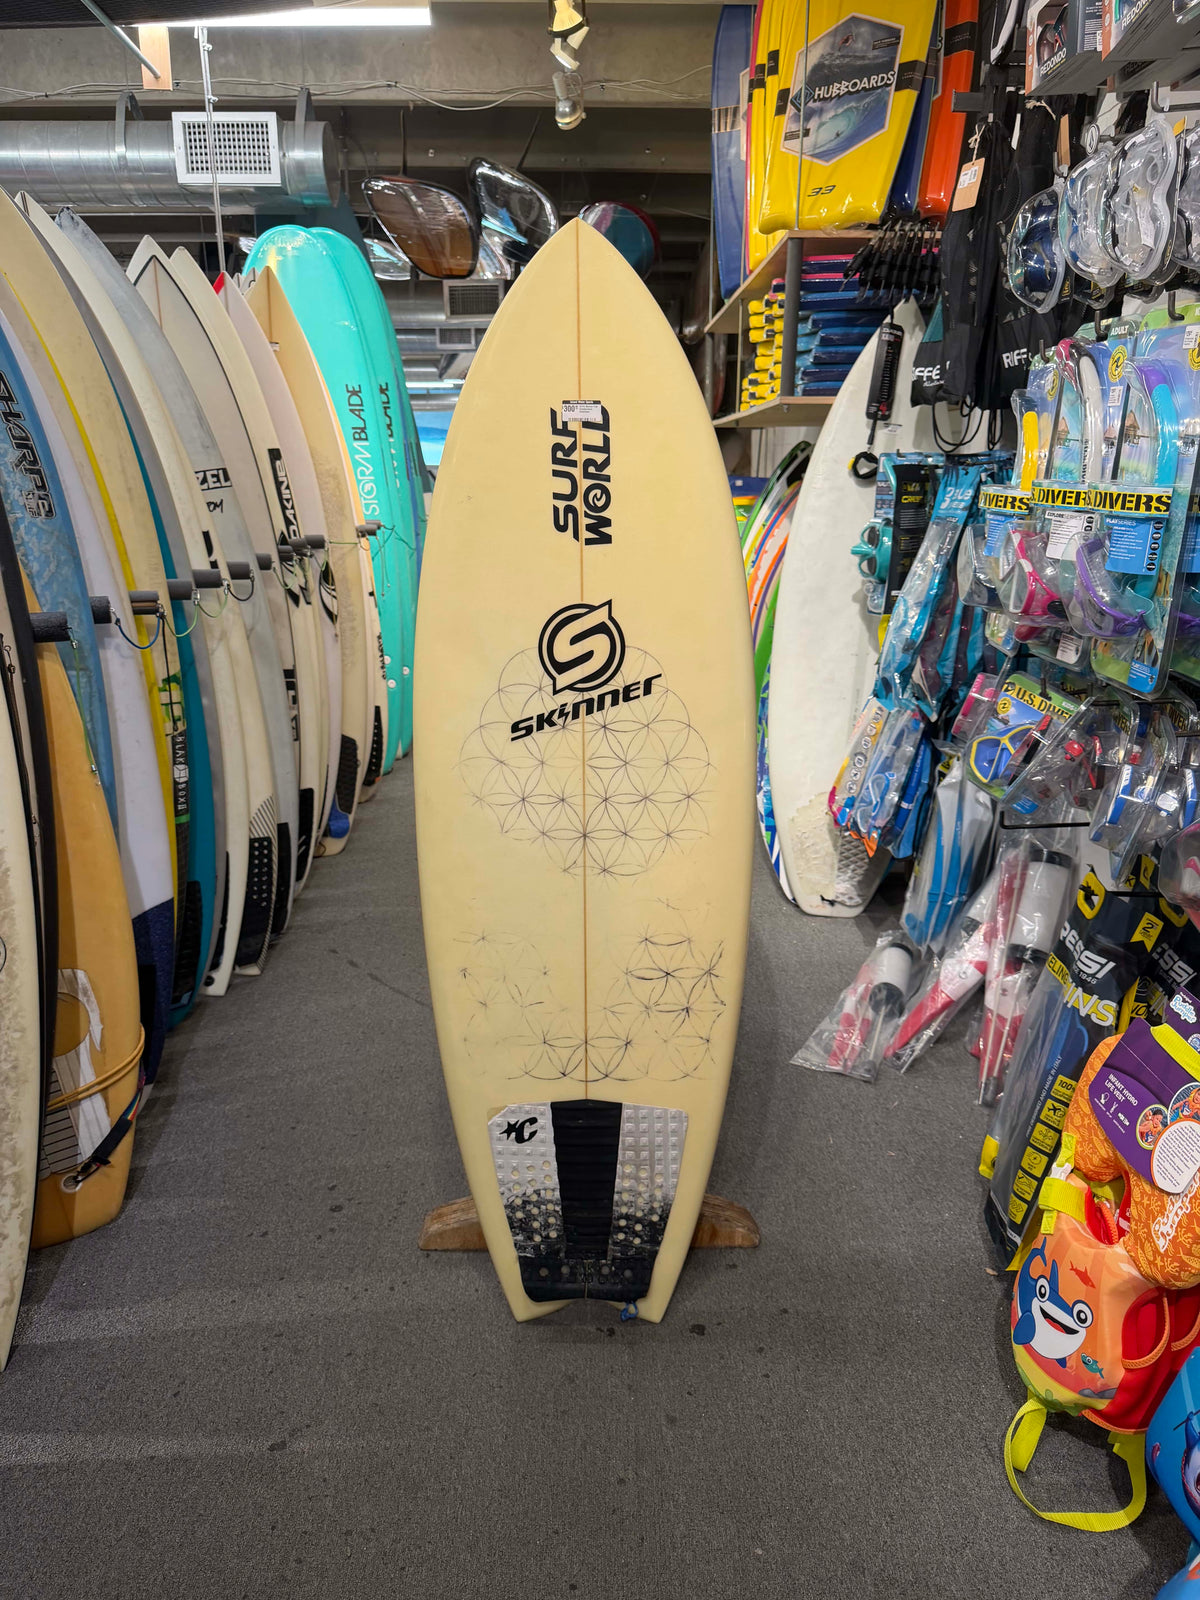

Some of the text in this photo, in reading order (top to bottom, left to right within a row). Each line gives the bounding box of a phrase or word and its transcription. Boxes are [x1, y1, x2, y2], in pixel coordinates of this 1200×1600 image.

[1039, 47, 1067, 77] REDONDO
[814, 71, 897, 100] HUBBOARDS
[808, 185, 836, 197] 33
[1110, 325, 1129, 336] ADULT
[345, 384, 380, 515] STORMBLADE
[550, 407, 579, 542] SURF
[582, 405, 612, 546] WORLD
[276, 460, 300, 540] DAKINE
[1094, 489, 1172, 513] DIVERS
[1016, 687, 1036, 708] U.S.
[1142, 922, 1154, 933] 2
[1104, 1079, 1116, 1092] LIFE
[1113, 1088, 1126, 1103] VEST
[1108, 1073, 1124, 1093] INFANT
[1122, 1089, 1138, 1106] HYDRO
